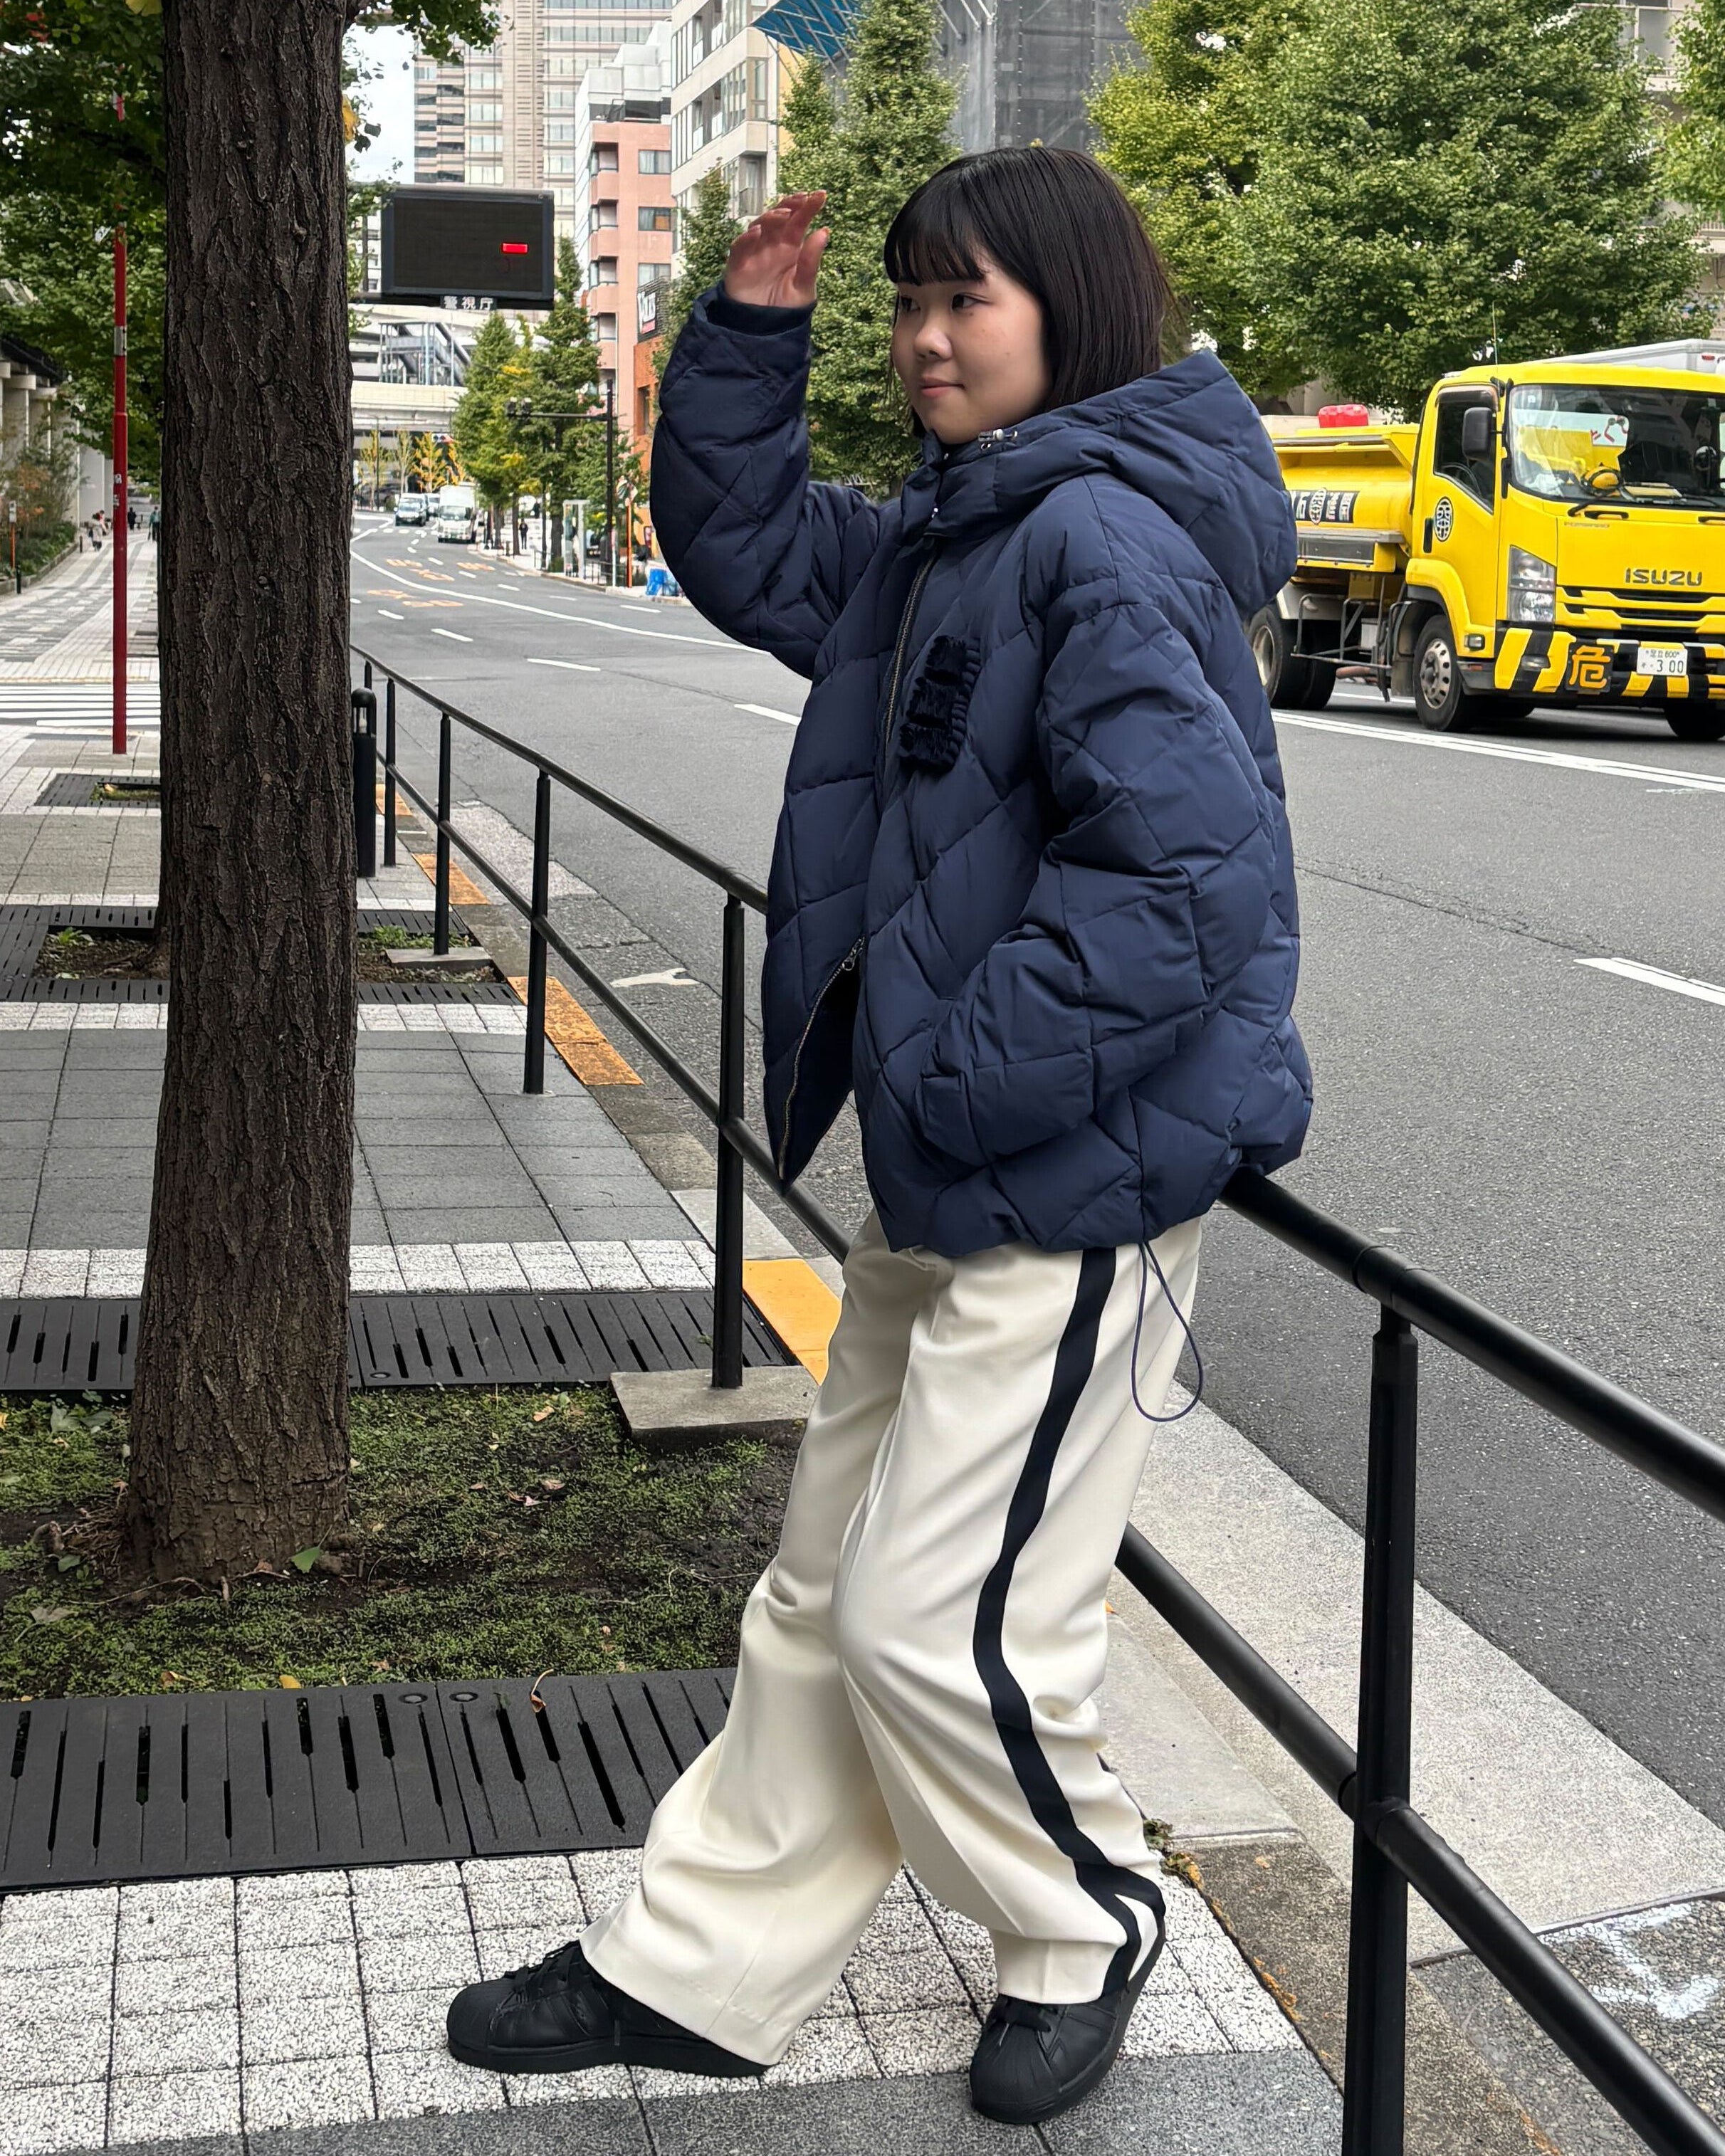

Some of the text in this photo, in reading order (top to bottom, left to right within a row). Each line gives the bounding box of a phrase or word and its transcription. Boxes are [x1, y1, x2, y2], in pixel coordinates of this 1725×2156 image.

[444, 295, 493, 310] 警視庁
[1625, 567, 1702, 587] ISUZU
[1568, 645, 1611, 688] 危
